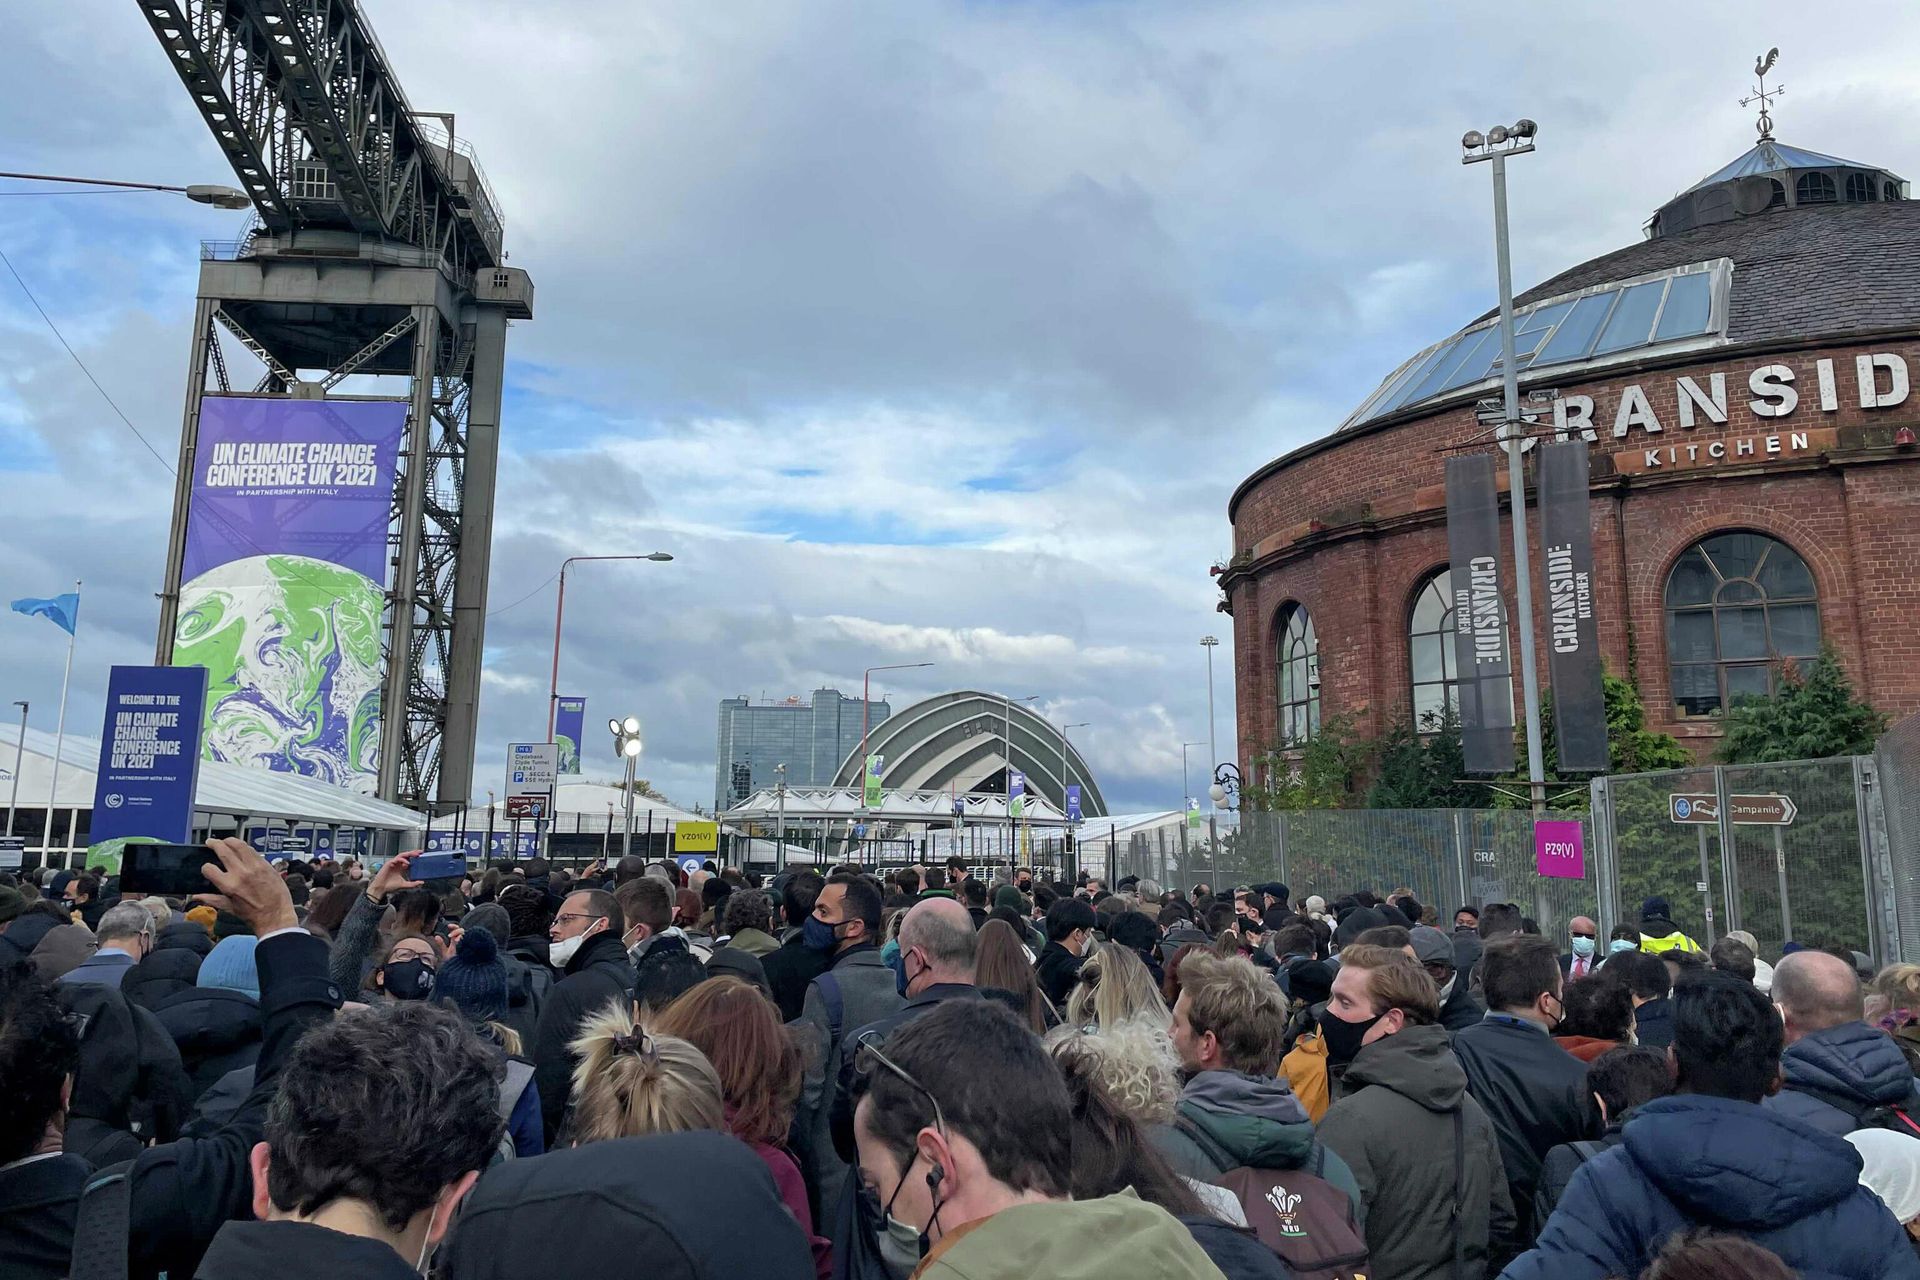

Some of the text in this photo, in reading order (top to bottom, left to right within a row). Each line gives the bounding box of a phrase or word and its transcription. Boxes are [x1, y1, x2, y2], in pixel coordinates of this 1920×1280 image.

[213, 443, 377, 465] UN CLIMATE CHANGE
[1645, 432, 1808, 467] KITCHEN
[206, 464, 377, 487] CONFERENCE UK 2021
[317, 488, 339, 496] ITALY
[1547, 543, 1579, 653] CRANSIDE
[1576, 572, 1592, 619] KITCHEN
[1456, 589, 1471, 635] KITCHEN
[1470, 556, 1501, 664] CRANSIDE
[119, 694, 181, 706] WELCOME TO THE
[116, 712, 179, 727] UN CLIMATE
[114, 726, 159, 740] CHANGE
[112, 740, 181, 755] CONFERENCE
[111, 754, 155, 769] UK 2021
[1731, 804, 1780, 815] Campanile
[1545, 842, 1575, 858] PZ9(V)
